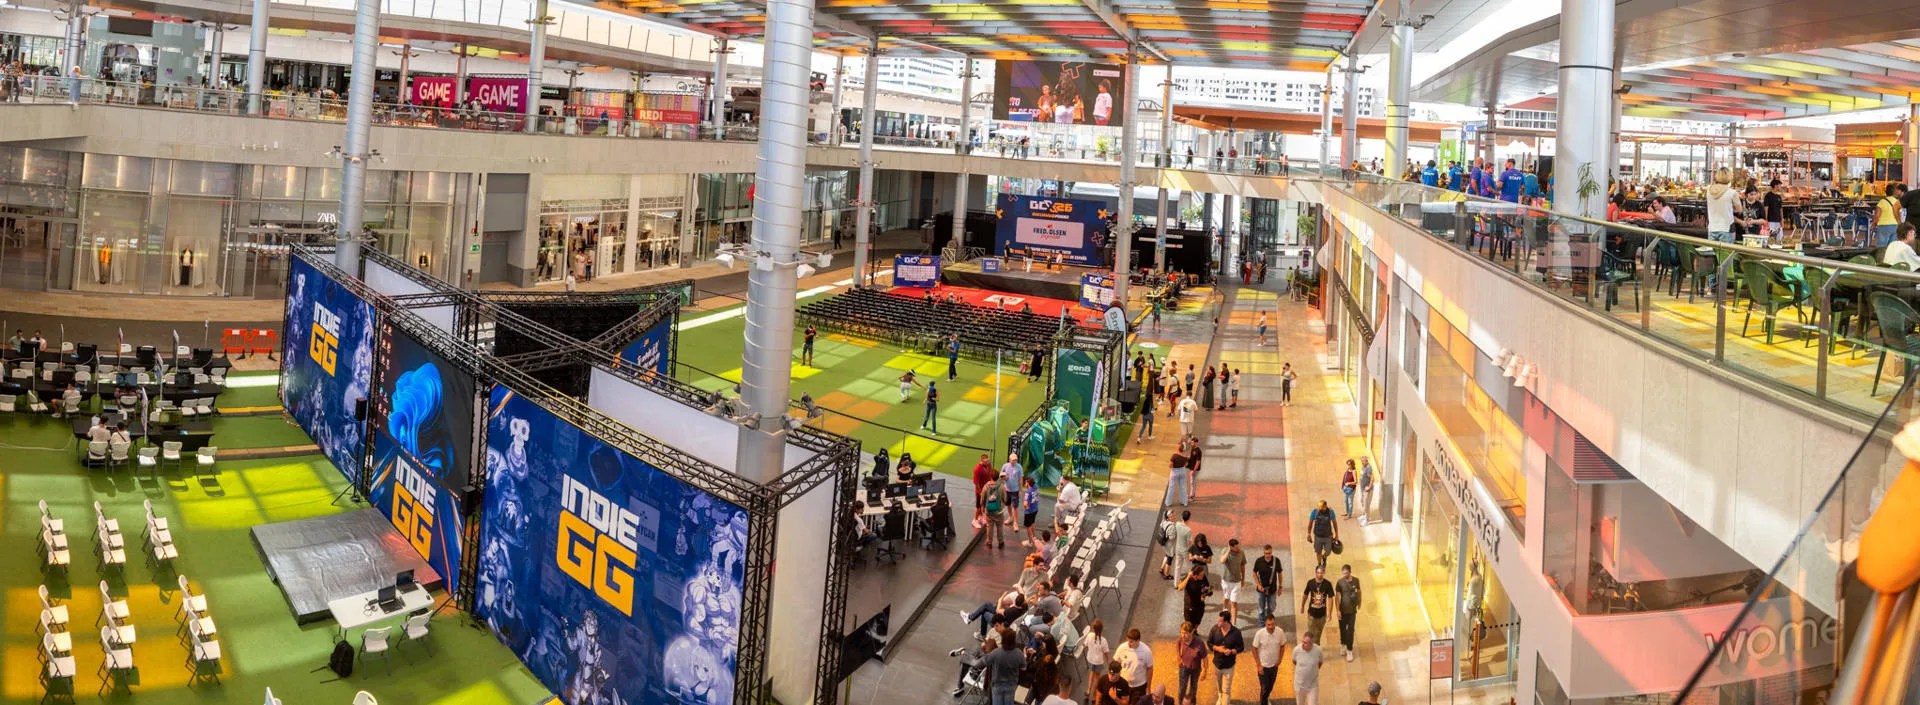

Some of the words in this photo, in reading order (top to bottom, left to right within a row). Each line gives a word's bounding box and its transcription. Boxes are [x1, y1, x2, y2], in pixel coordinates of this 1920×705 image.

[419, 82, 451, 102] GAME
[480, 84, 519, 107] GAME
[639, 109, 663, 121] REDI
[313, 301, 341, 339] INDIE
[309, 322, 339, 378] GG
[395, 455, 437, 515] INDIE
[391, 481, 434, 562] GG
[561, 473, 640, 552] INDIE
[556, 509, 638, 618] GG
[1431, 651, 1447, 663] 25
